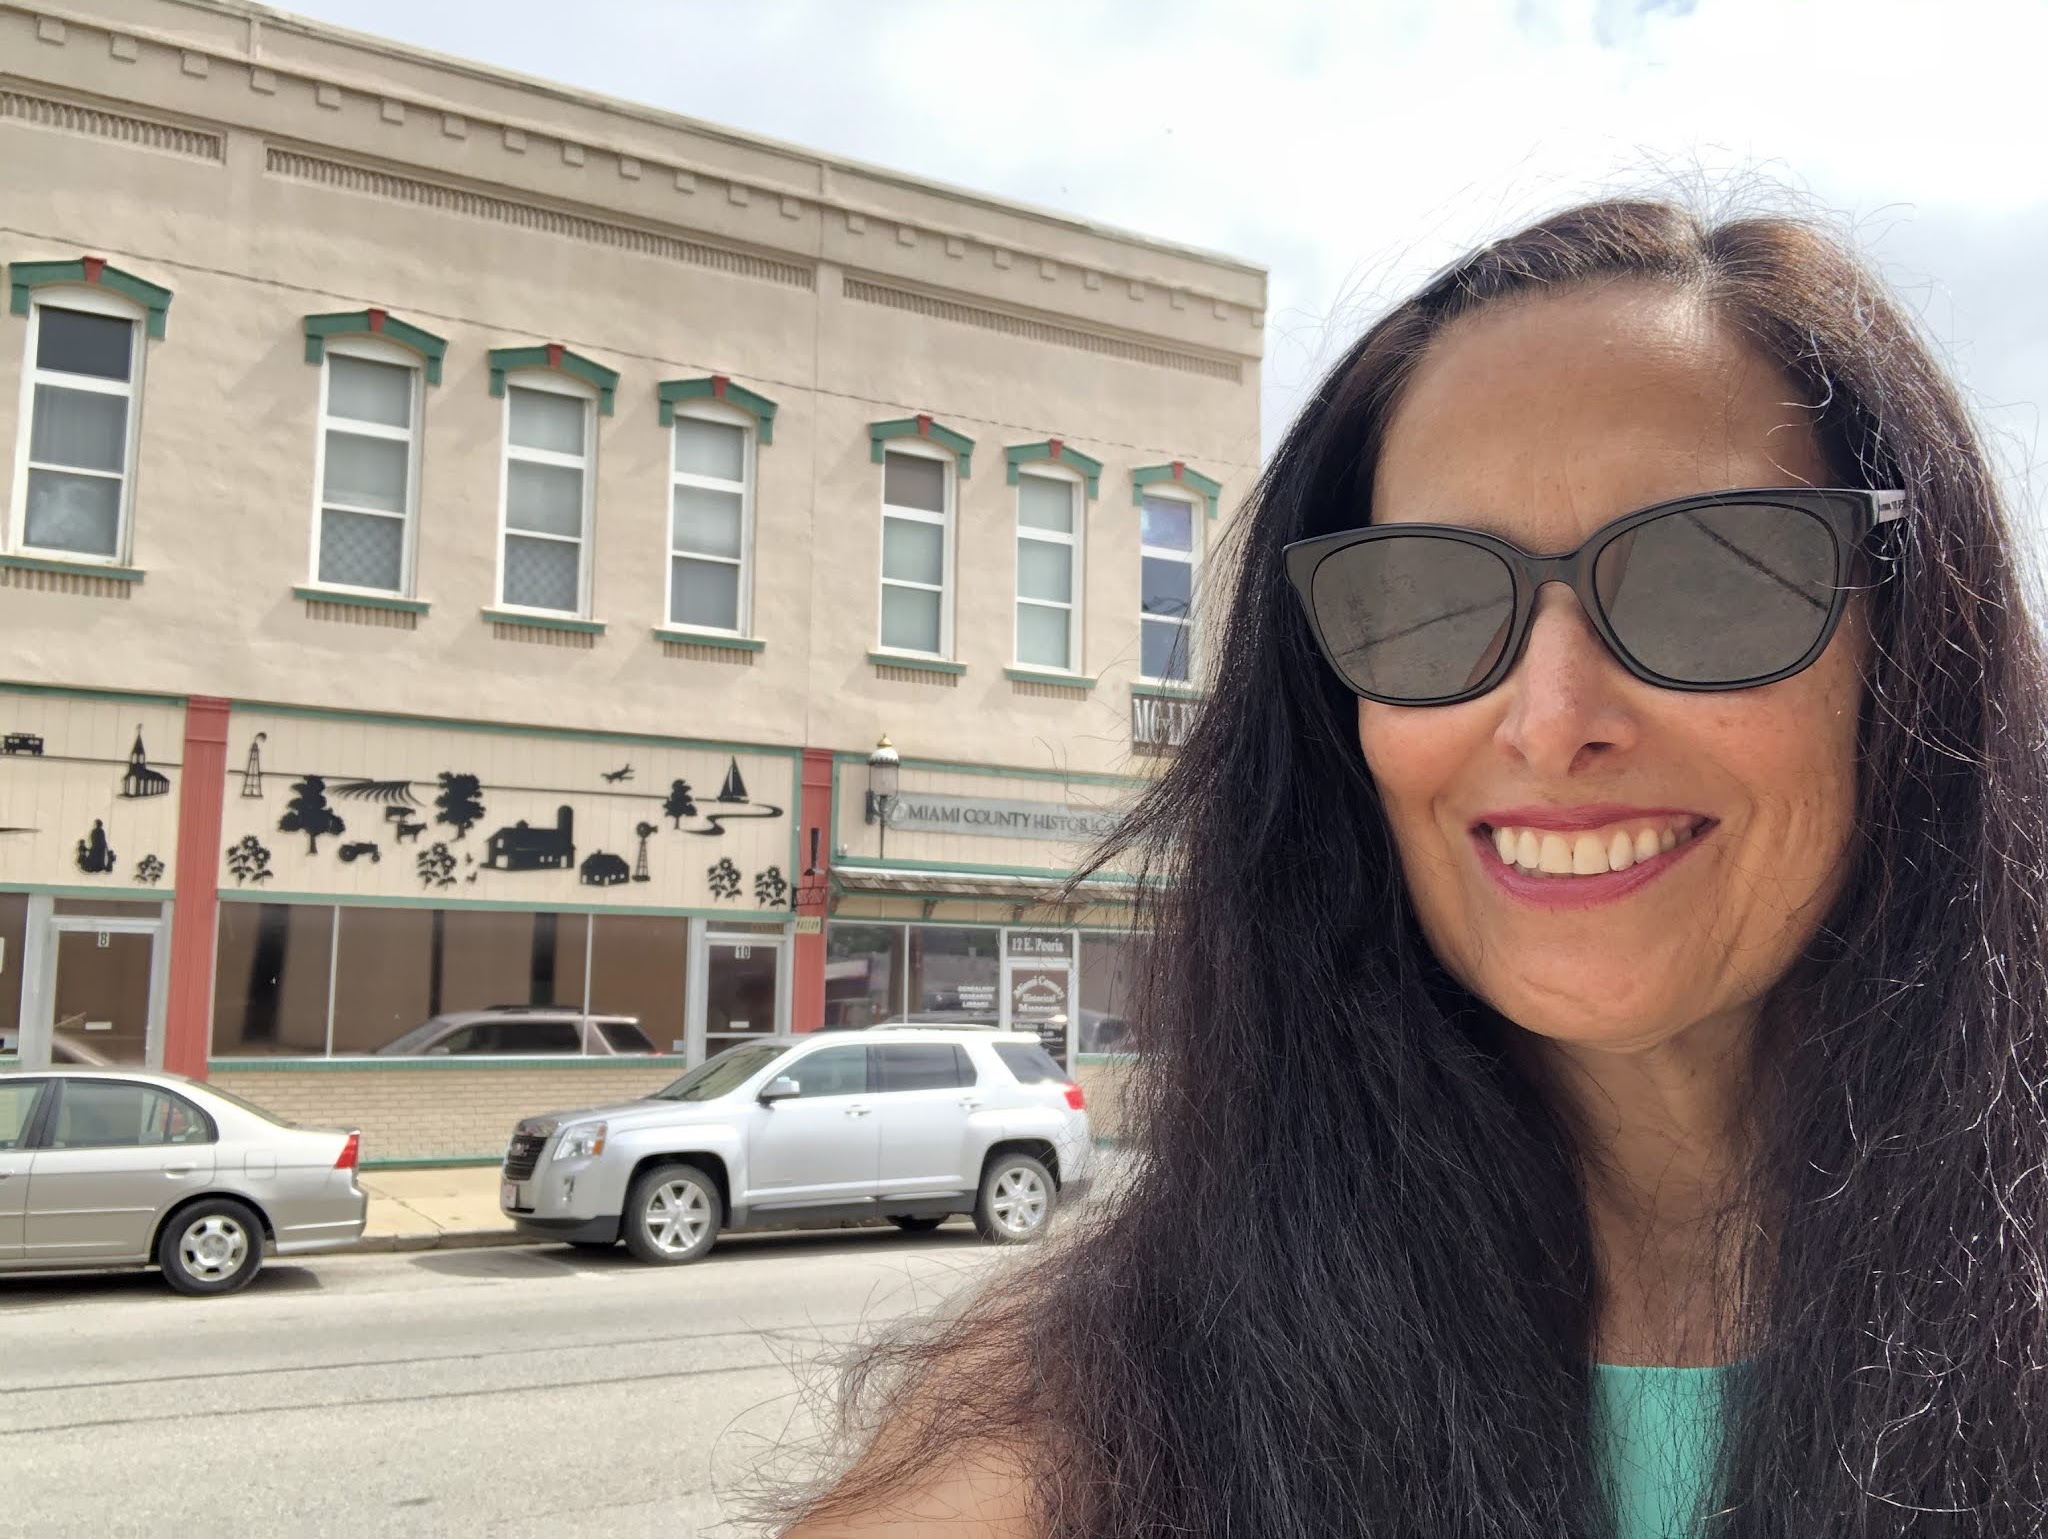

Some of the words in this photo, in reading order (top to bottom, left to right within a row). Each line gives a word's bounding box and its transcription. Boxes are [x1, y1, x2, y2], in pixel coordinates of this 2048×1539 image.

[908, 804, 960, 822] MIAMI
[963, 808, 1031, 827] COUNTY
[1033, 813, 1123, 833] HISTORICA
[99, 931, 108, 946] 8
[1012, 938, 1022, 951] 12
[1023, 938, 1034, 951] E.
[1035, 938, 1064, 952] Peoria
[737, 944, 750, 958] 10
